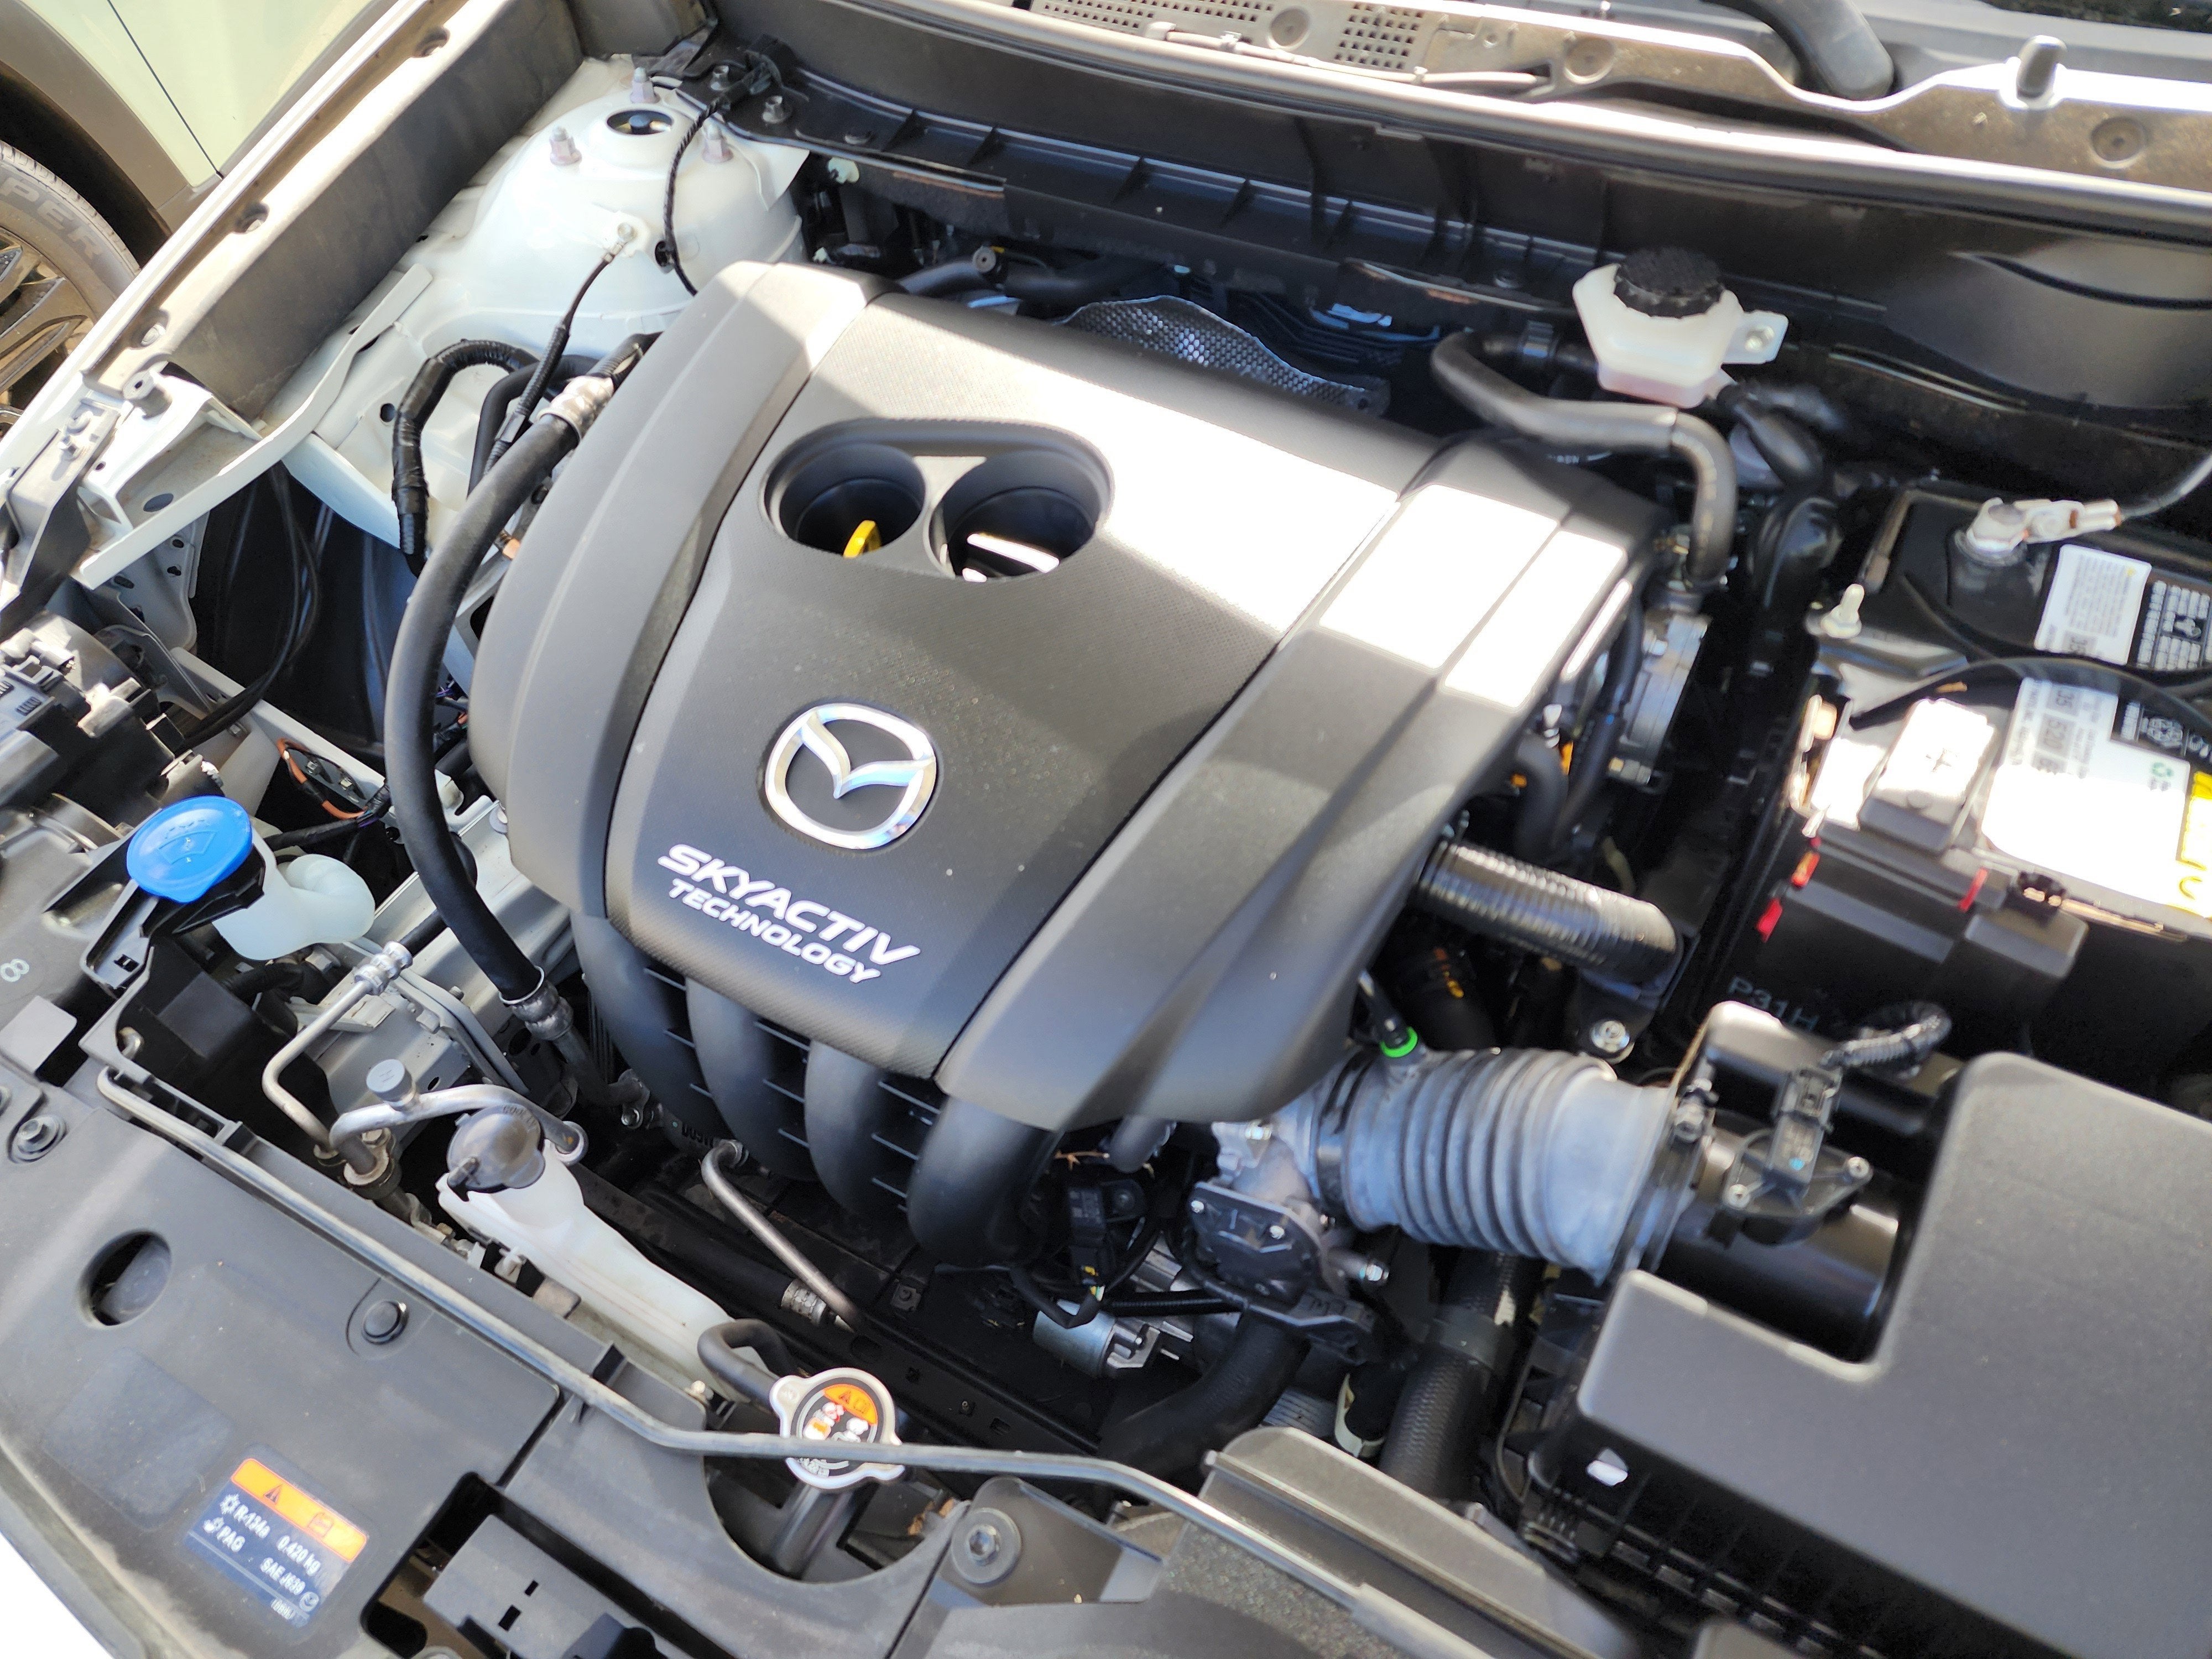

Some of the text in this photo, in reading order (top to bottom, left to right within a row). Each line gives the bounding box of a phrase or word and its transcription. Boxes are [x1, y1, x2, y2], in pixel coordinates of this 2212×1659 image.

[658, 844, 921, 965] SKYACTIV
[669, 878, 881, 983] TECHNOLOGY
[216, 1525, 246, 1553] PAG
[260, 1557, 286, 1581] SAE
[233, 1504, 270, 1538] R-134a
[304, 1553, 321, 1577] kg
